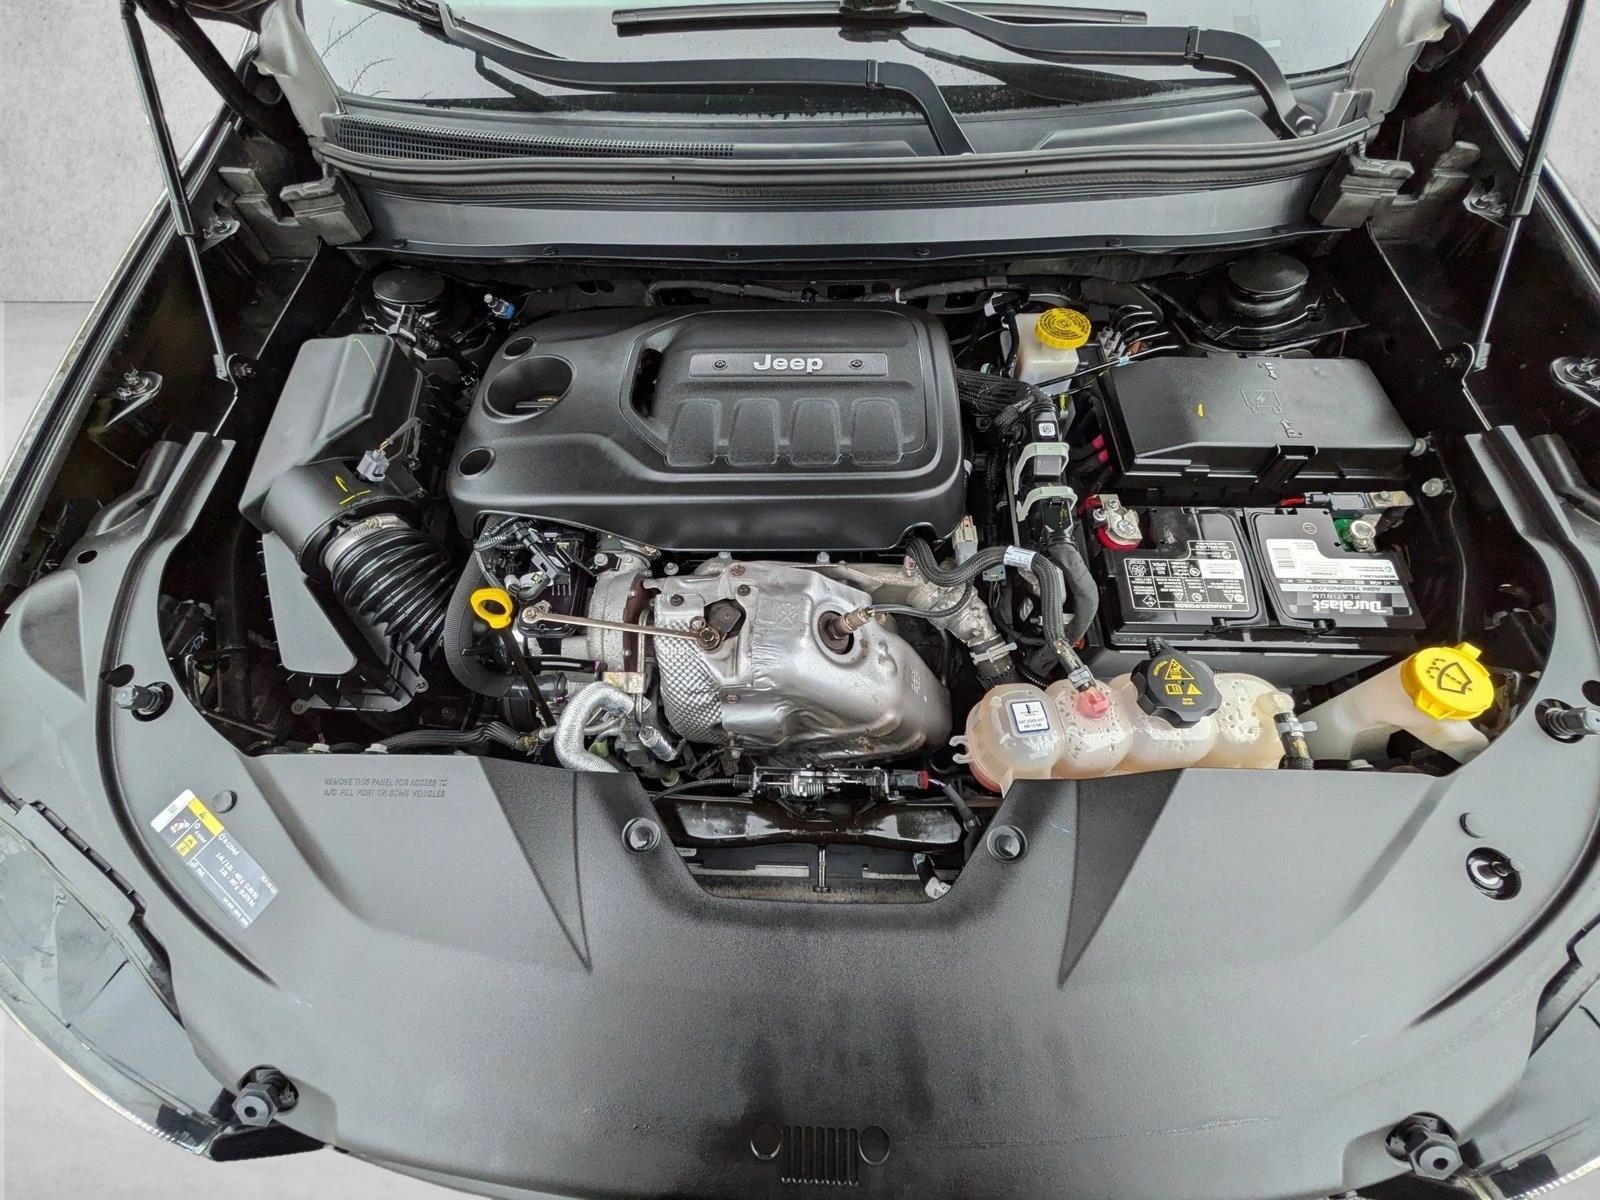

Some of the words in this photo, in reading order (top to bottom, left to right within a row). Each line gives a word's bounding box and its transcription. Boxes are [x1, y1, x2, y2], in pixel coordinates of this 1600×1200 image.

[753, 354, 823, 374] Jeep
[1313, 600, 1387, 613] Duralast
[324, 777, 353, 786] REMOVE
[354, 777, 370, 786] THIS
[370, 778, 393, 786] PANEL
[395, 778, 410, 786] FOR
[410, 778, 437, 787] ACCESS
[438, 779, 448, 787] TO
[340, 788, 353, 797] FILL
[356, 789, 375, 797] PORT
[377, 789, 389, 797] ON
[389, 789, 410, 798] SOME
[411, 789, 446, 798] VEHICLES
